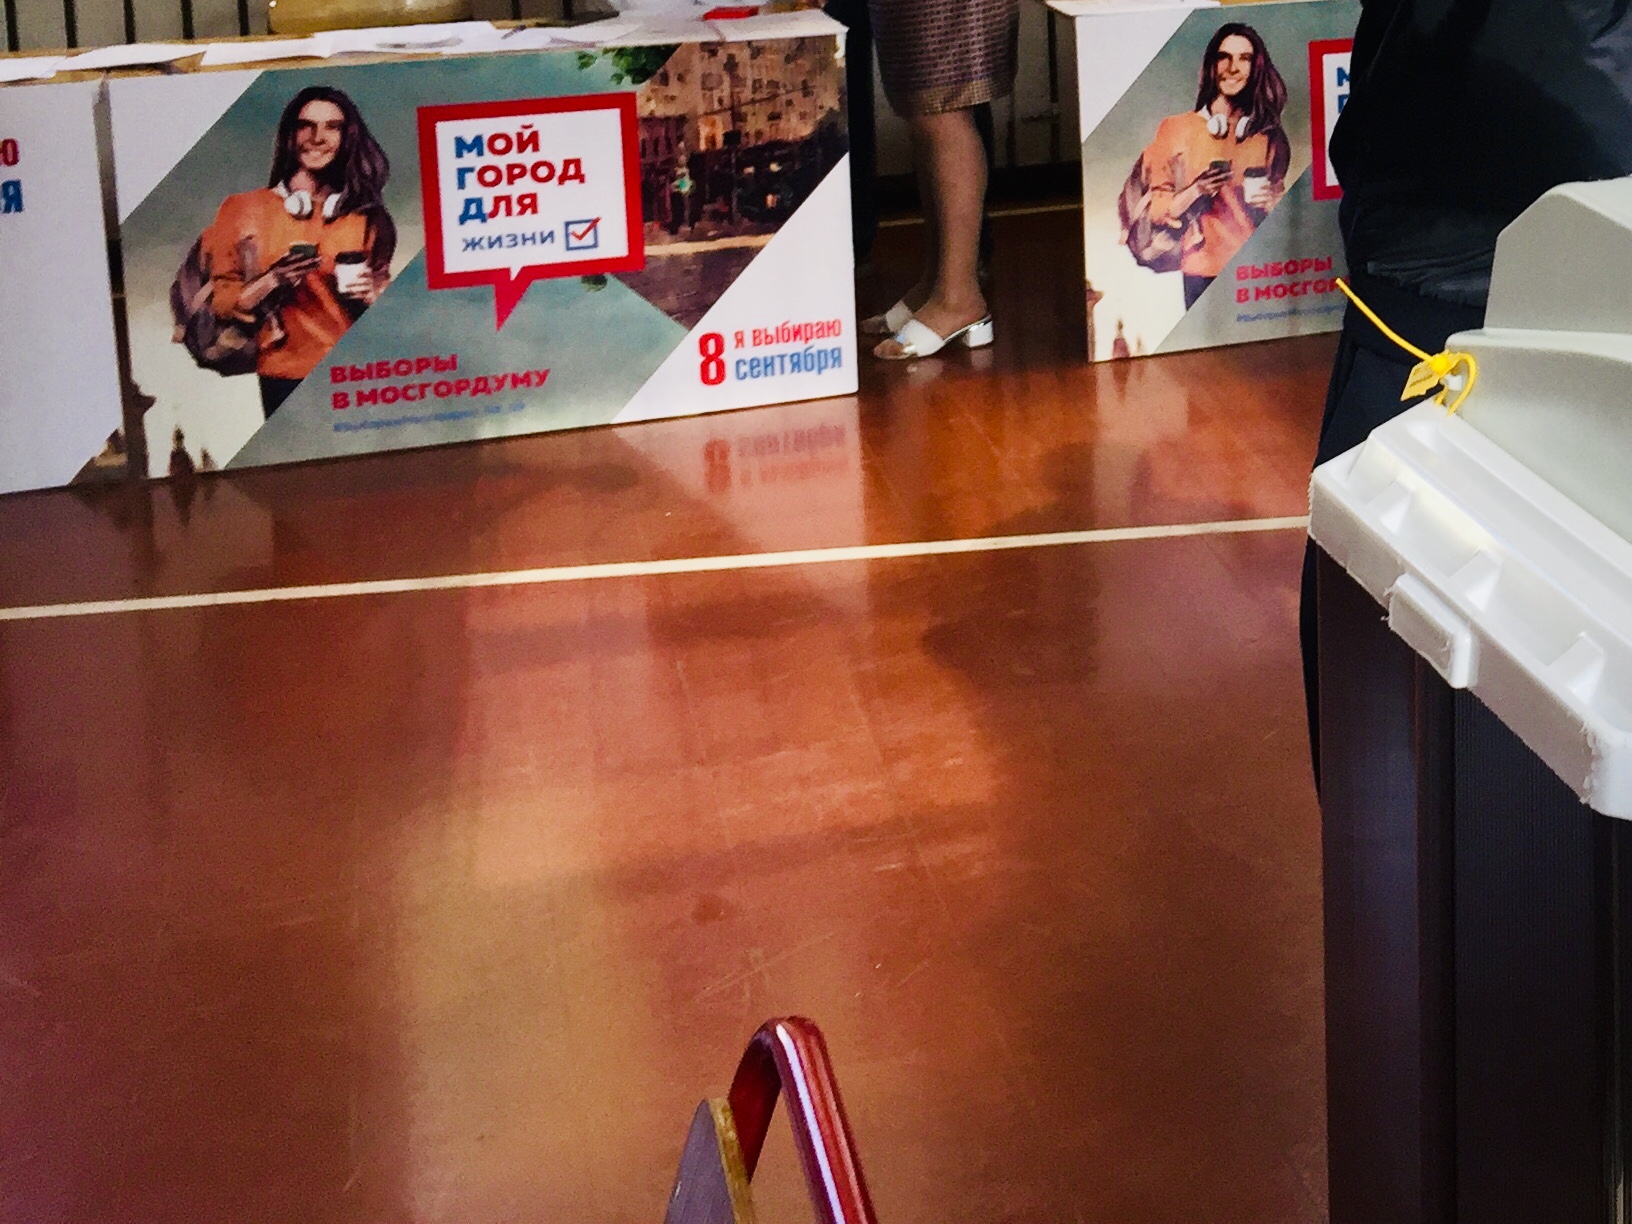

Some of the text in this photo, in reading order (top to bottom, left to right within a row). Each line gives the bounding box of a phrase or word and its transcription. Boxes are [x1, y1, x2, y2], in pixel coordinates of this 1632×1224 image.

[454, 123, 540, 158] МОЙ
[456, 157, 585, 190] ГОРОД
[458, 192, 539, 225] ДЛЯ
[1236, 256, 1333, 282] ВЫБОРЫ
[1236, 288, 1250, 304] В
[734, 318, 842, 349] я выбираю
[330, 354, 458, 384] ВЫБОРЫ
[699, 332, 726, 386] 8
[735, 345, 843, 381] сентября
[331, 368, 551, 410] В МОСГОРДУМУ
